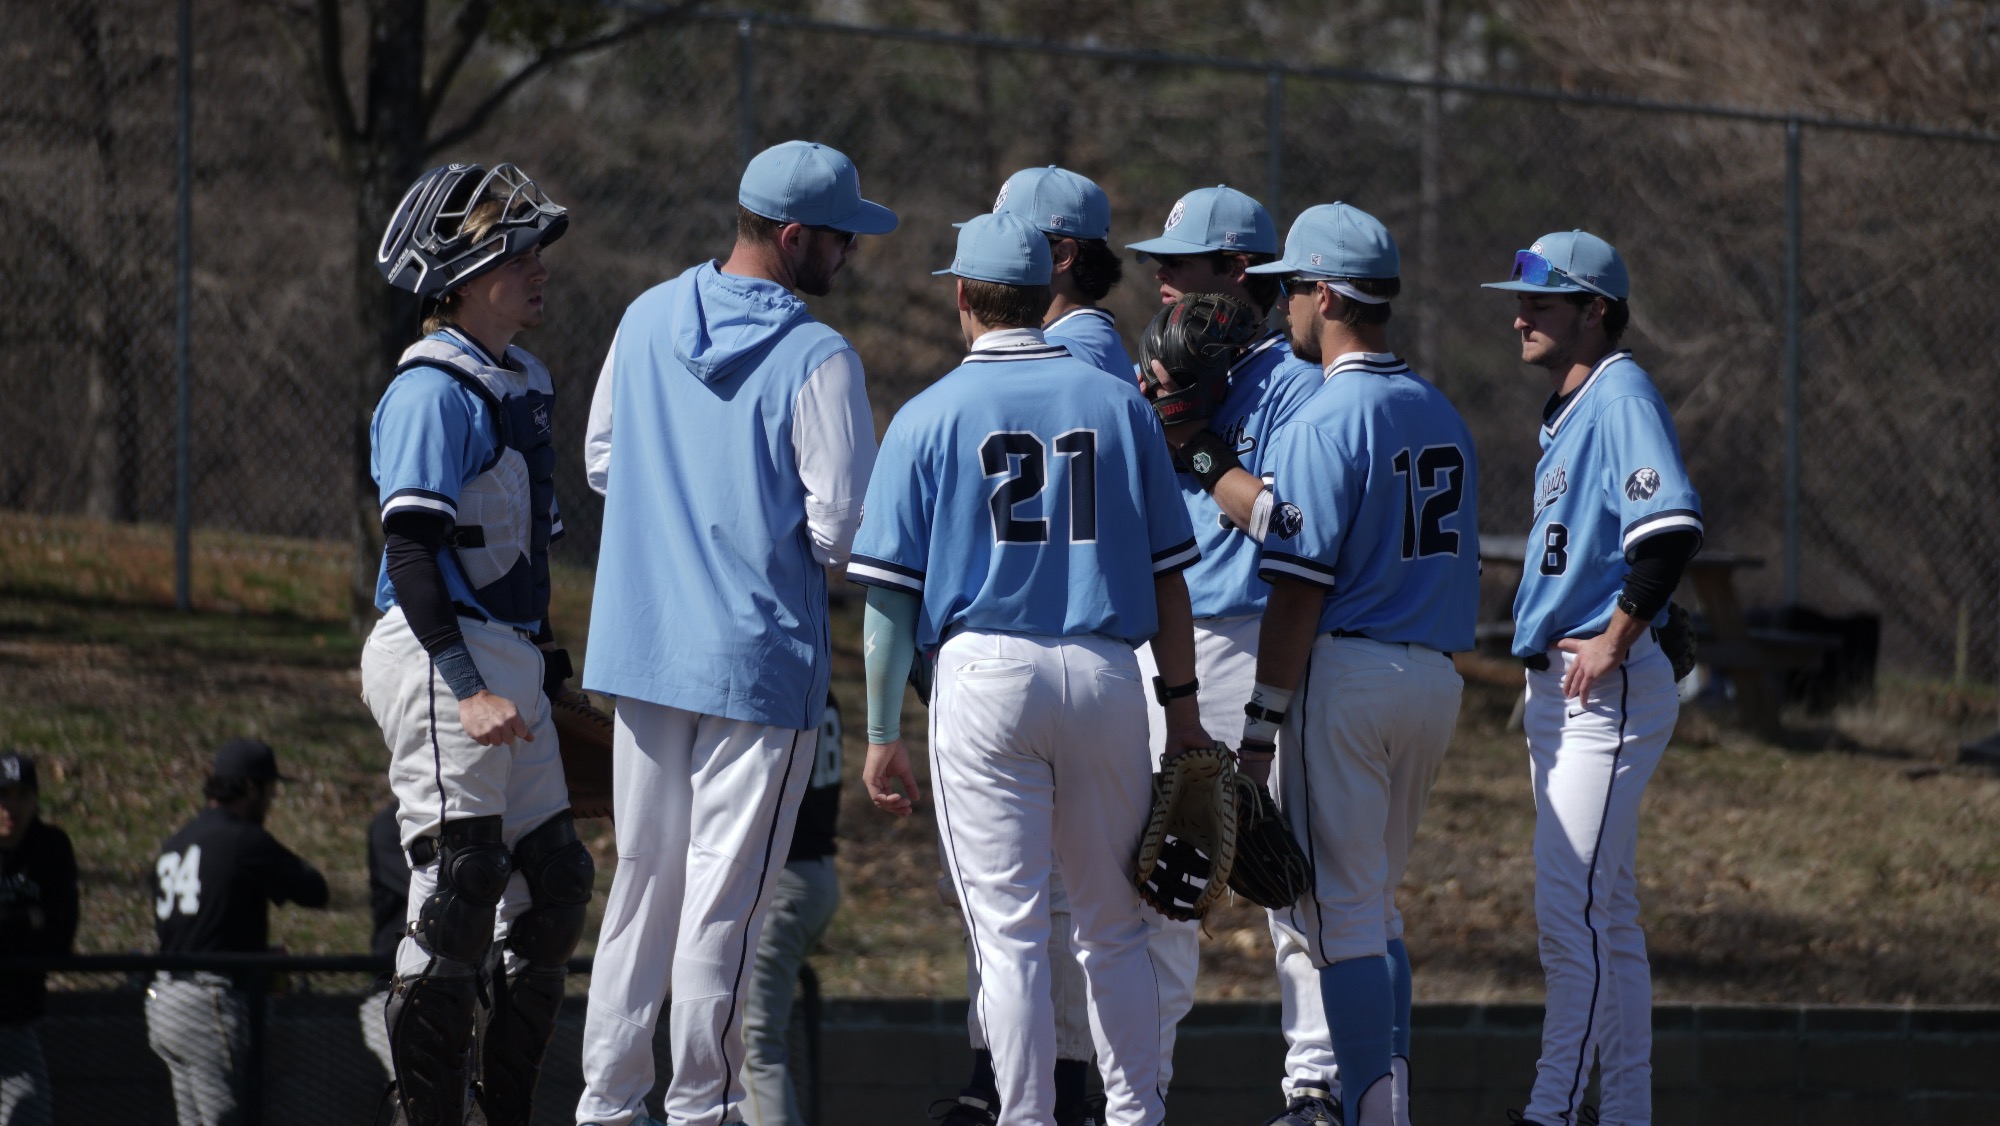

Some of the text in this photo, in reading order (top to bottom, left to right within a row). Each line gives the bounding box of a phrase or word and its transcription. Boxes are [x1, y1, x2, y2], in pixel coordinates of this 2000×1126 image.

[977, 427, 1099, 548] 21
[1391, 443, 1466, 561] 12
[1539, 521, 1569, 577] 8
[156, 843, 202, 920] 34
